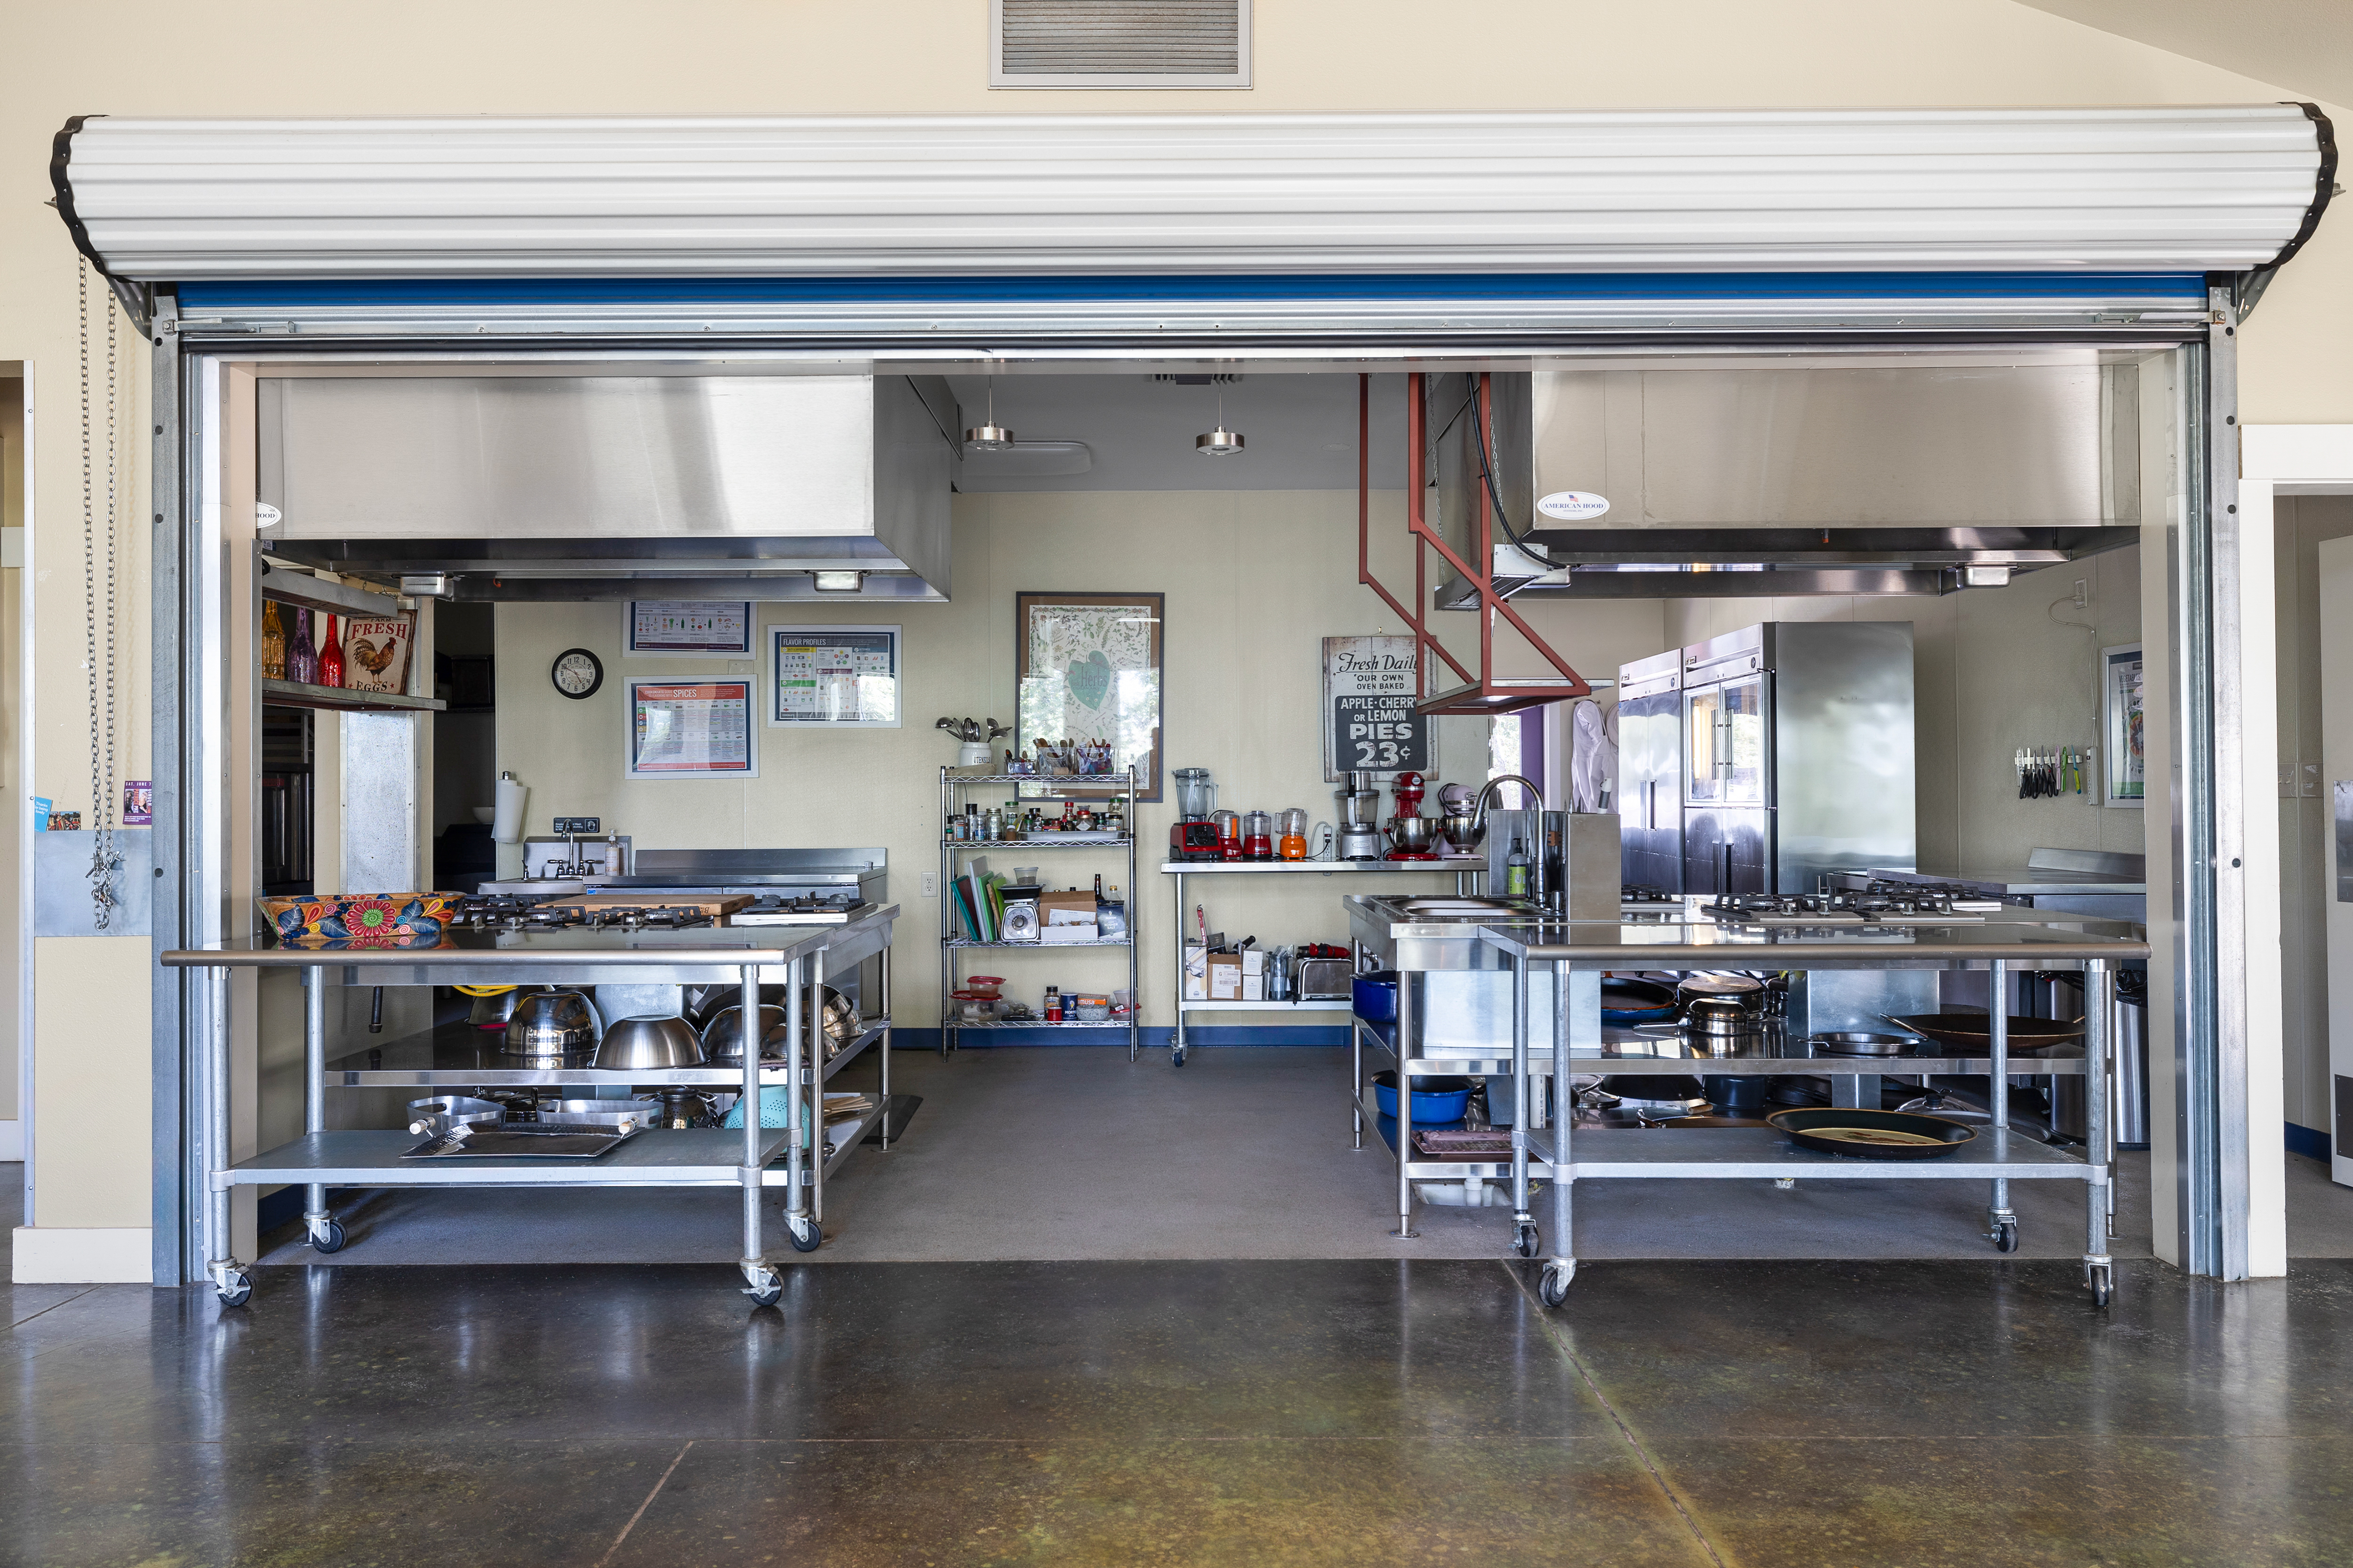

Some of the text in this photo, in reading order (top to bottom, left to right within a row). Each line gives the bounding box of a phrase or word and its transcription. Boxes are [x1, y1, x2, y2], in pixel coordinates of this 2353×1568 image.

[350, 623, 408, 640] FRESH
[1338, 653, 1378, 672] Fresh
[1081, 666, 1107, 687] Herbs
[356, 680, 388, 692] EGGS
[673, 689, 697, 698] SPICES
[1341, 697, 1374, 709] APPLE
[1368, 710, 1406, 721] LEMON
[1350, 723, 1413, 739] PIES
